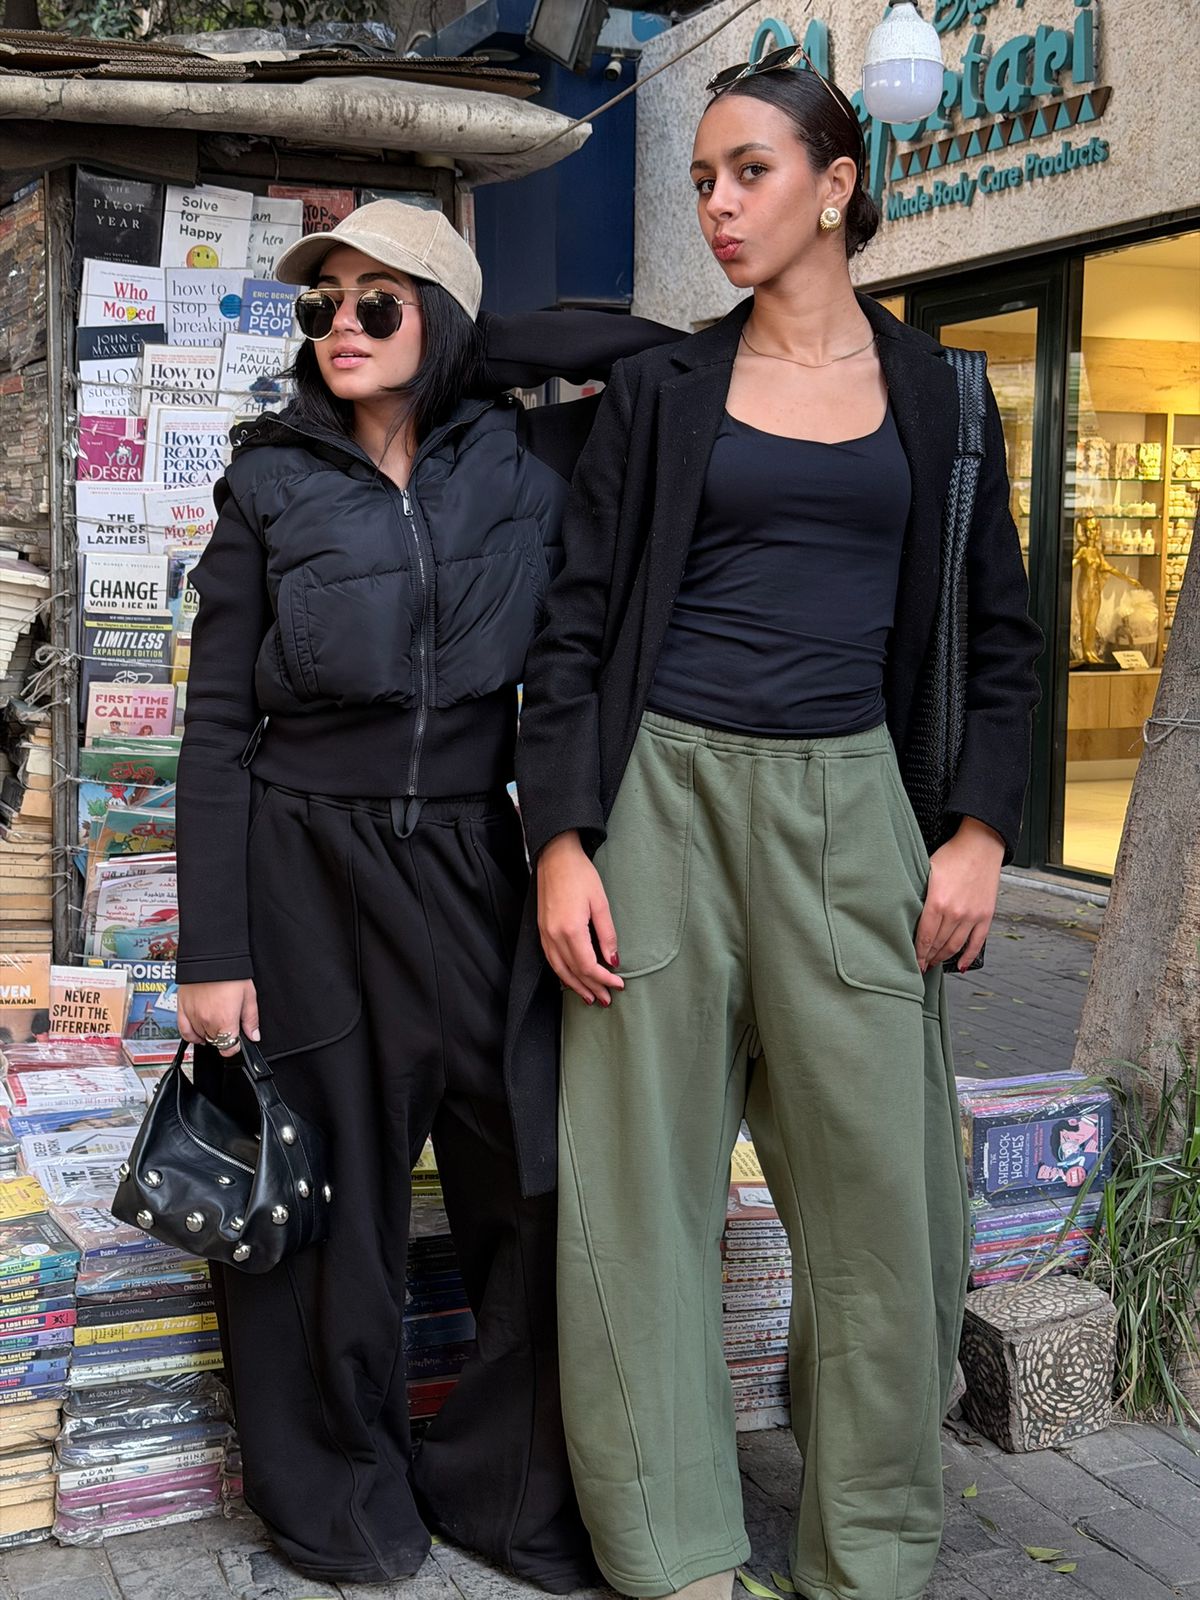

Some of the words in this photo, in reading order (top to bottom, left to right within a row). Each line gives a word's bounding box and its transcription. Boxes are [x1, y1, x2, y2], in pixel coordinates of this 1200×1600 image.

[886, 184, 932, 221] Made
[932, 172, 978, 208] Body
[977, 164, 1024, 195] Care
[1023, 137, 1110, 183] Products
[93, 198, 145, 213] PIVOT
[182, 195, 219, 212] Solve
[96, 214, 141, 230] YEAR
[180, 210, 201, 223] for
[253, 213, 271, 222] am
[179, 223, 222, 243] Happy
[262, 230, 284, 245] hero
[256, 254, 275, 272] my
[113, 281, 148, 301] Who
[172, 280, 206, 297] how
[211, 283, 227, 296] to
[252, 290, 269, 298] ERIC
[270, 291, 295, 301] BERNE
[172, 301, 207, 318] stop
[172, 316, 240, 334] breaking
[97, 333, 127, 346] JOHN
[240, 352, 281, 366] PAULA
[194, 367, 215, 380] TO
[150, 392, 214, 407] PERSON
[164, 431, 205, 446] HOW
[208, 433, 229, 446] TO
[104, 450, 140, 467] YOU
[164, 447, 207, 460] READ
[210, 448, 221, 459] A
[163, 472, 199, 486] LIKE
[201, 472, 213, 483] A
[107, 513, 136, 523] THE
[170, 504, 205, 521] Who
[96, 525, 123, 534] ART
[87, 535, 149, 545] LAZINES
[89, 579, 159, 601] CHANGE
[93, 630, 166, 650] LIMITLESS
[92, 647, 131, 657] EXPANDED
[133, 649, 163, 658] EDITION
[95, 693, 169, 706] FIRST-TIME
[94, 705, 168, 719] CALLER
[134, 982, 168, 993] AISONS
[64, 989, 101, 1005] NEVER
[52, 1004, 88, 1020] SPLIT
[87, 1006, 109, 1021] THE
[50, 1019, 112, 1035] IFFERENCE
[33, 1140, 48, 1158] DEEP
[998, 1132, 1011, 1186] SHERLOCK
[1011, 1134, 1025, 1179] HOLMES
[24, 1288, 39, 1298] Kids
[100, 1307, 145, 1317] BELLADONNA
[6, 1320, 22, 1328] Last
[22, 1317, 40, 1326] Kids
[21, 1350, 36, 1358] Kids
[17, 1389, 33, 1397] Kids
[176, 1452, 206, 1463] THINK
[80, 1466, 114, 1479] ADAM
[76, 1474, 117, 1487] GRANT
